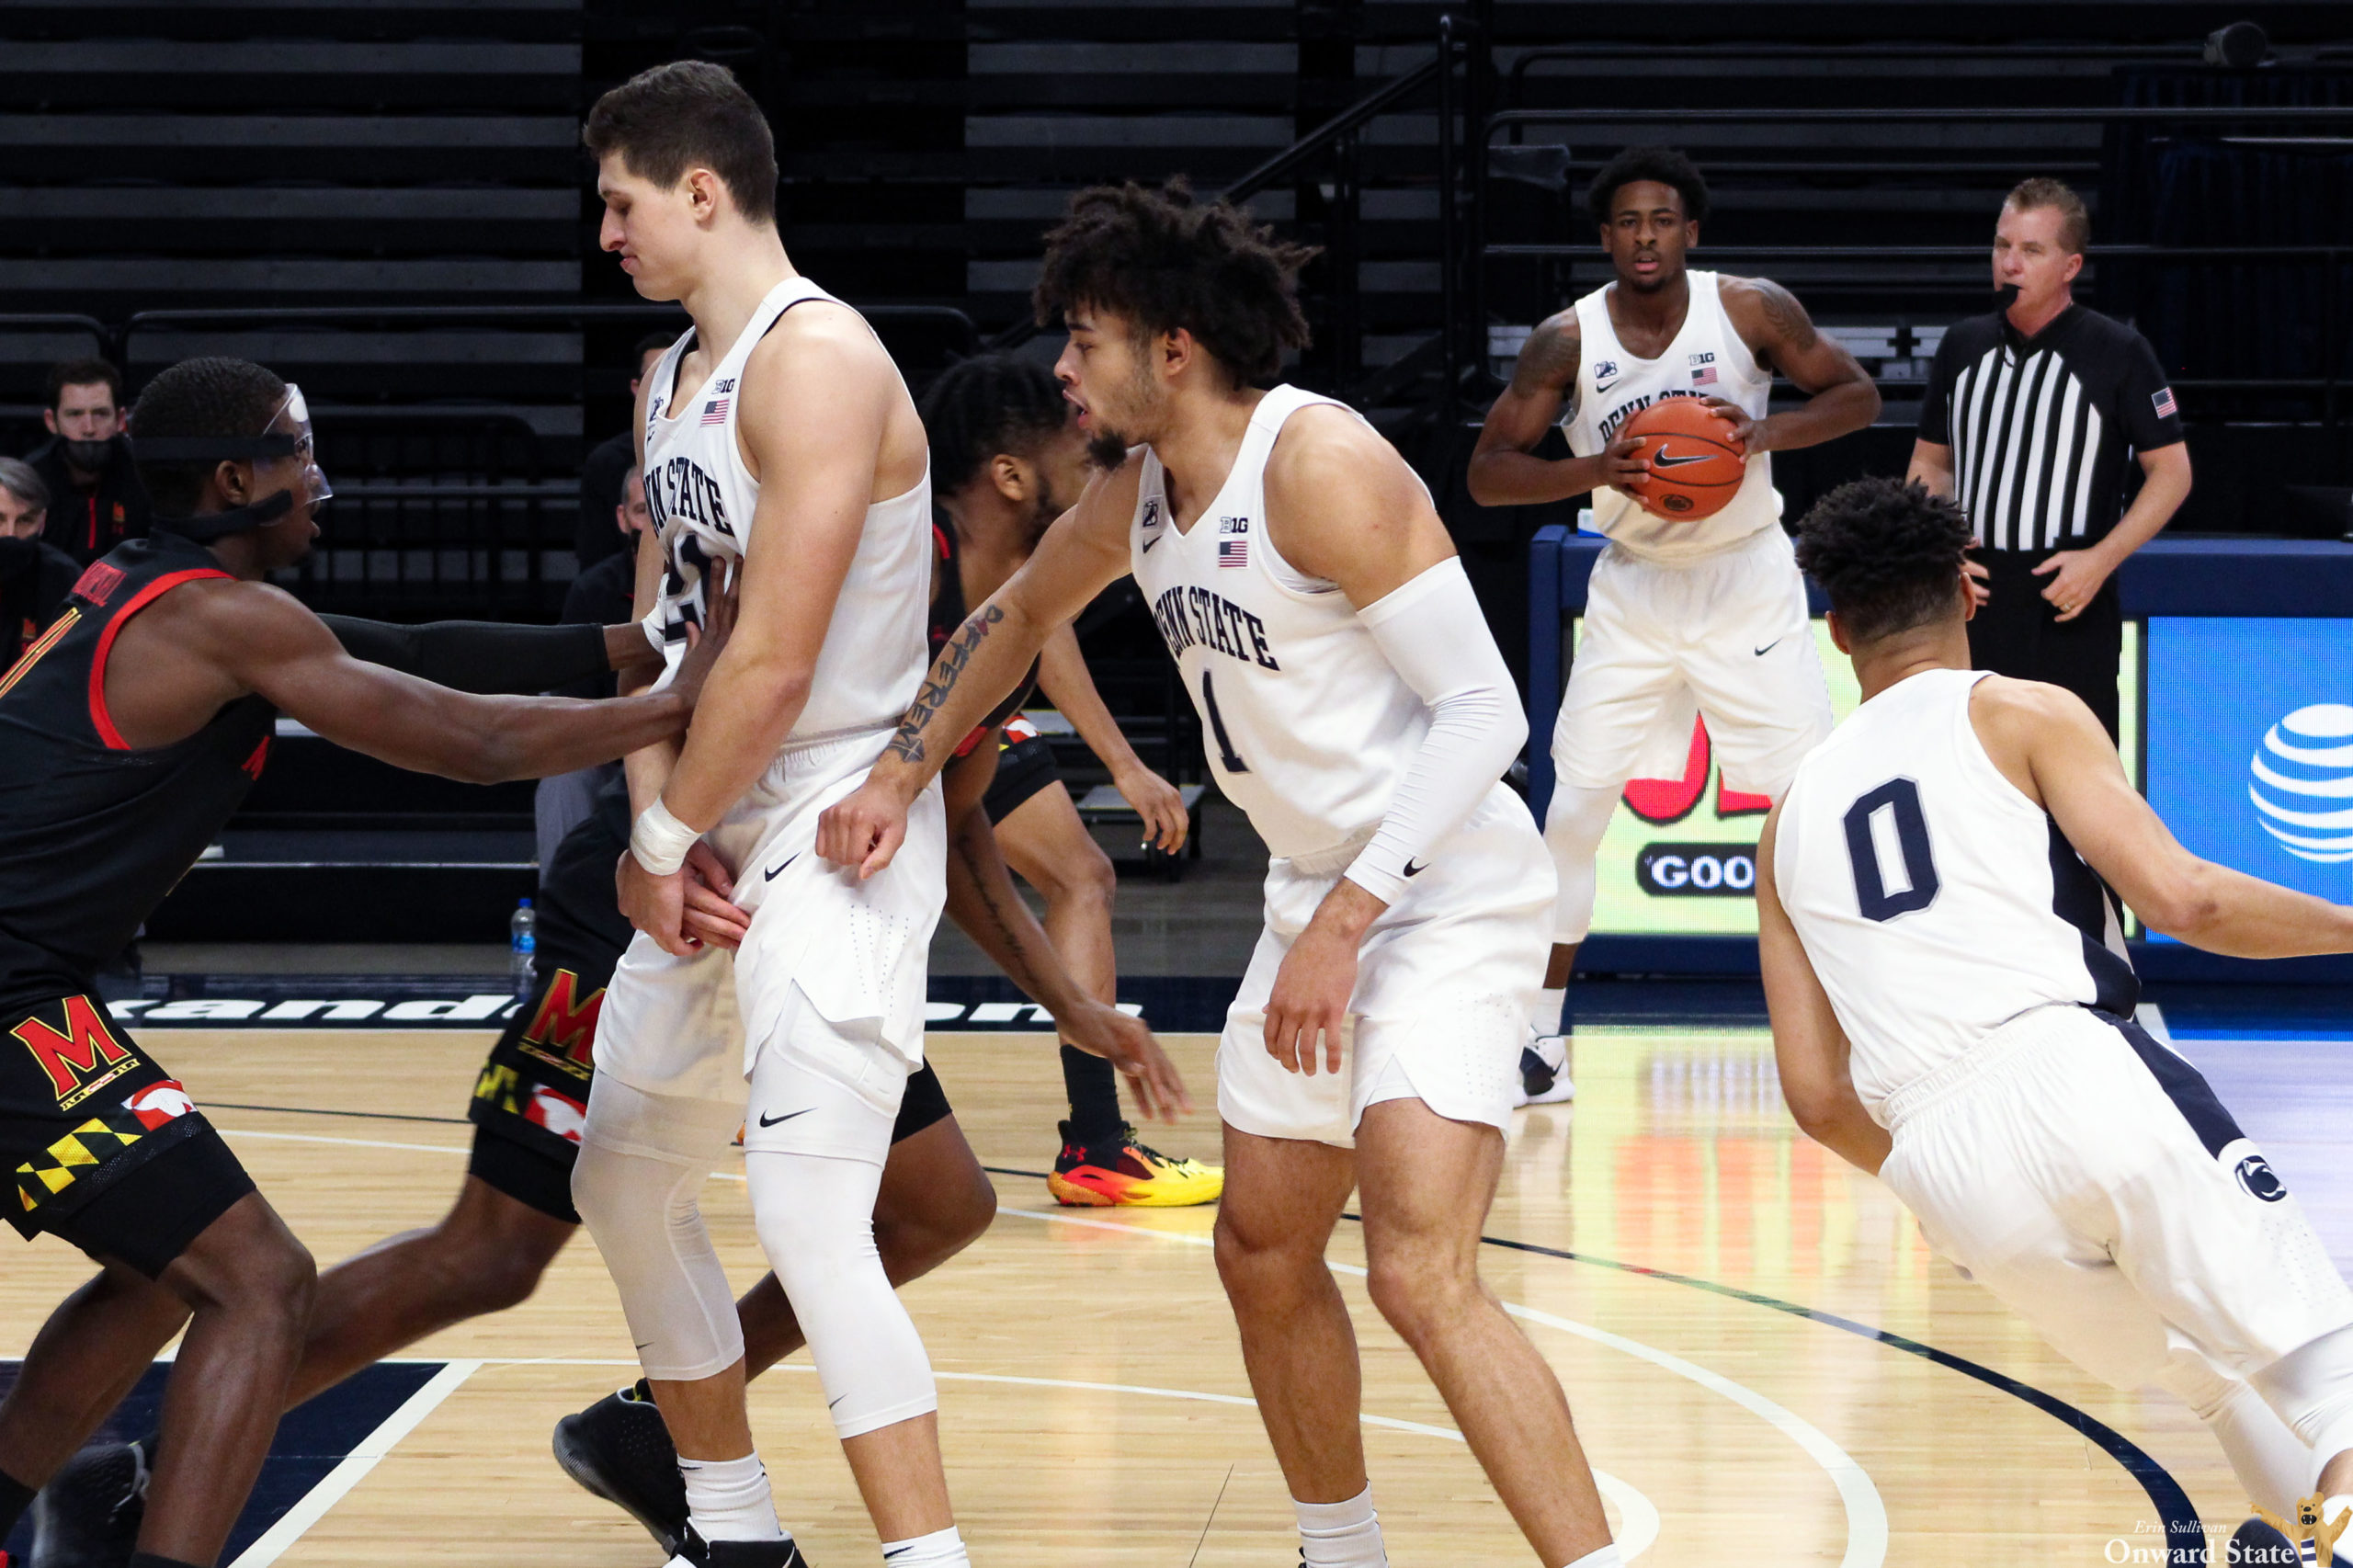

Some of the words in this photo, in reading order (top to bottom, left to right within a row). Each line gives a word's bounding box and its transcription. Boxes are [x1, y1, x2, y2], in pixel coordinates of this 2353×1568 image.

[667, 457, 736, 538] STATE
[1189, 585, 1280, 672] STATE
[1200, 666, 1252, 774] 1
[1839, 774, 1943, 924] 0
[9, 994, 133, 1101] M
